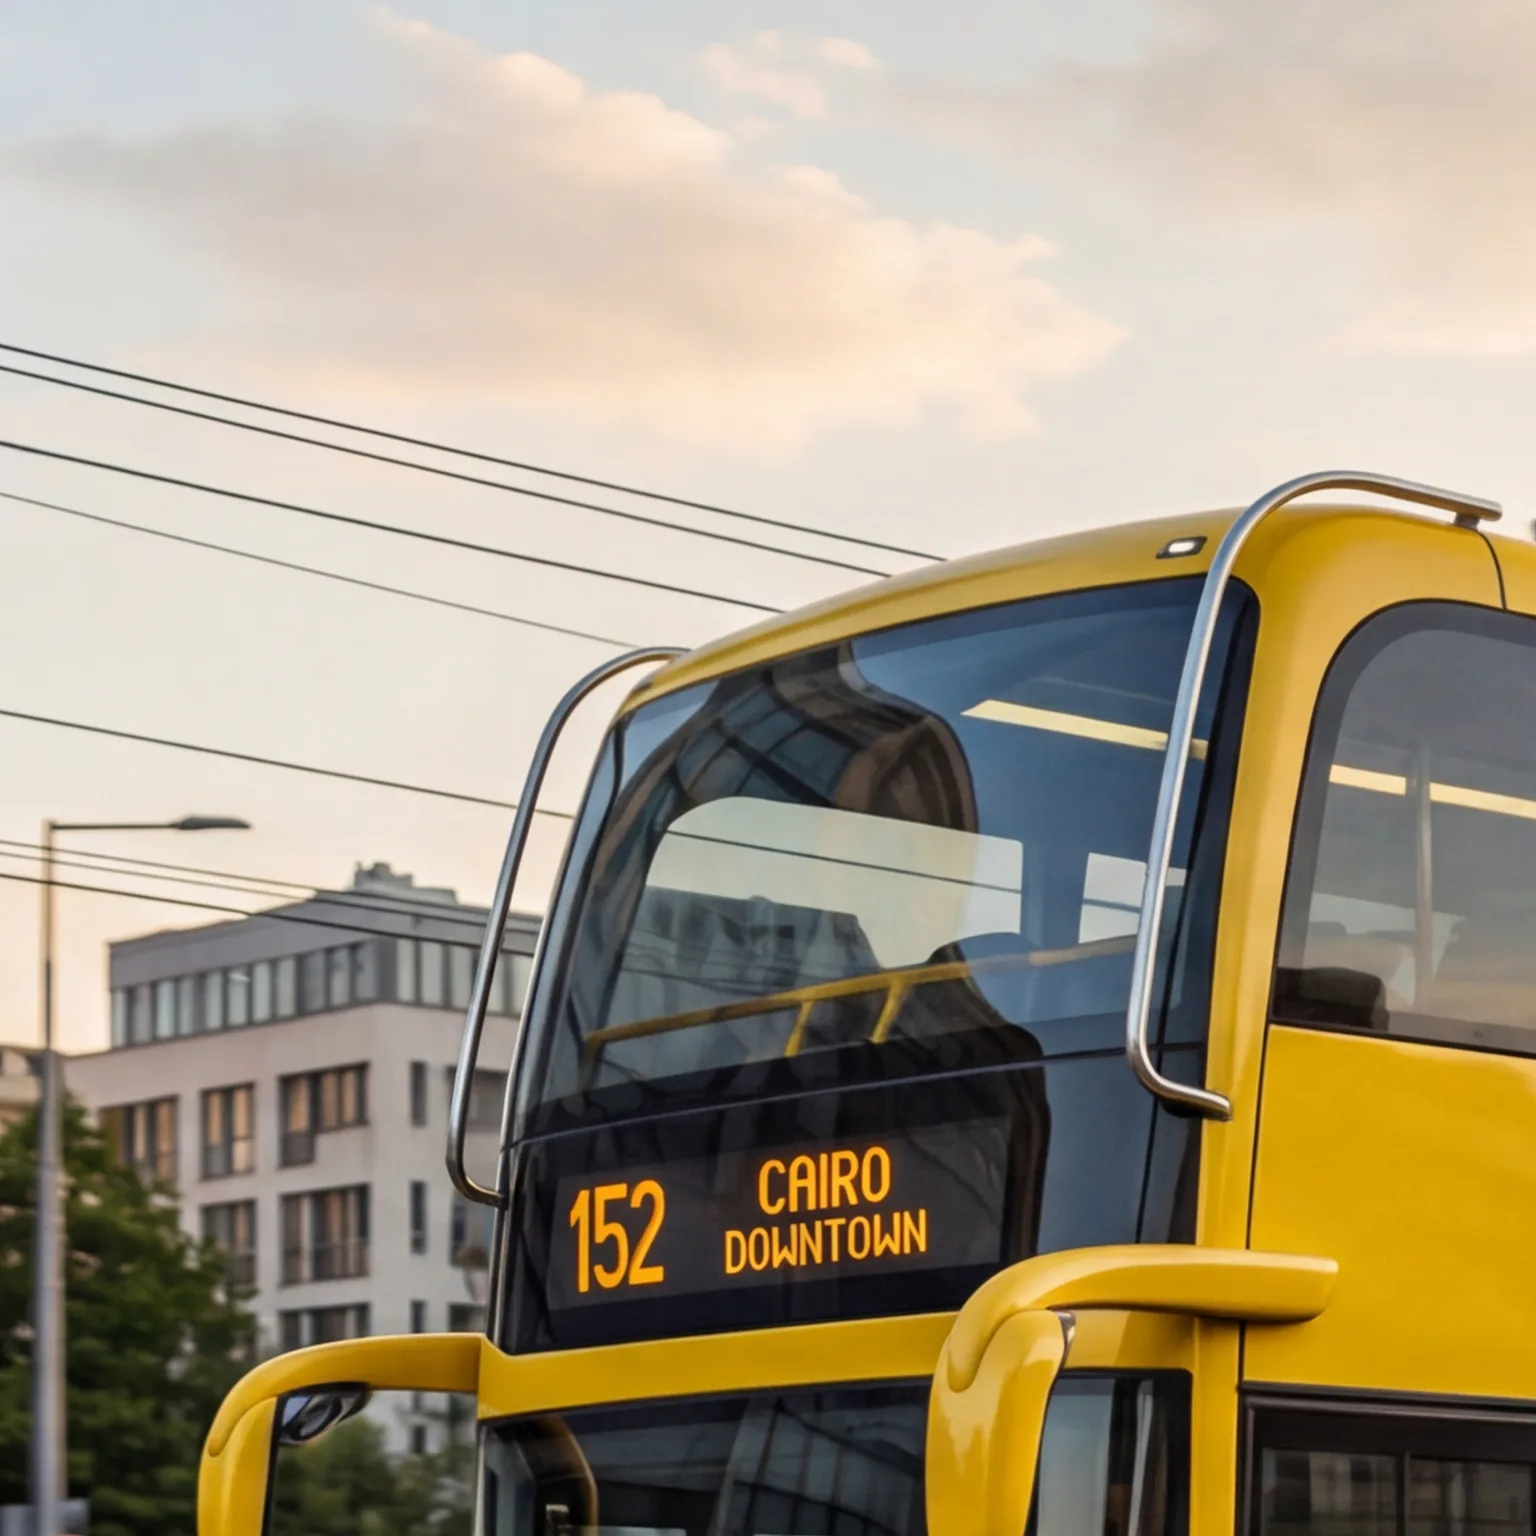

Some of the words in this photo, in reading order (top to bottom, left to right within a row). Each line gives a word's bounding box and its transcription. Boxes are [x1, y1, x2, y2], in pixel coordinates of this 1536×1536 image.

[758, 1146, 891, 1215] CAIRO
[569, 1179, 665, 1293] 152
[725, 1208, 927, 1275] DOWNTOWN
